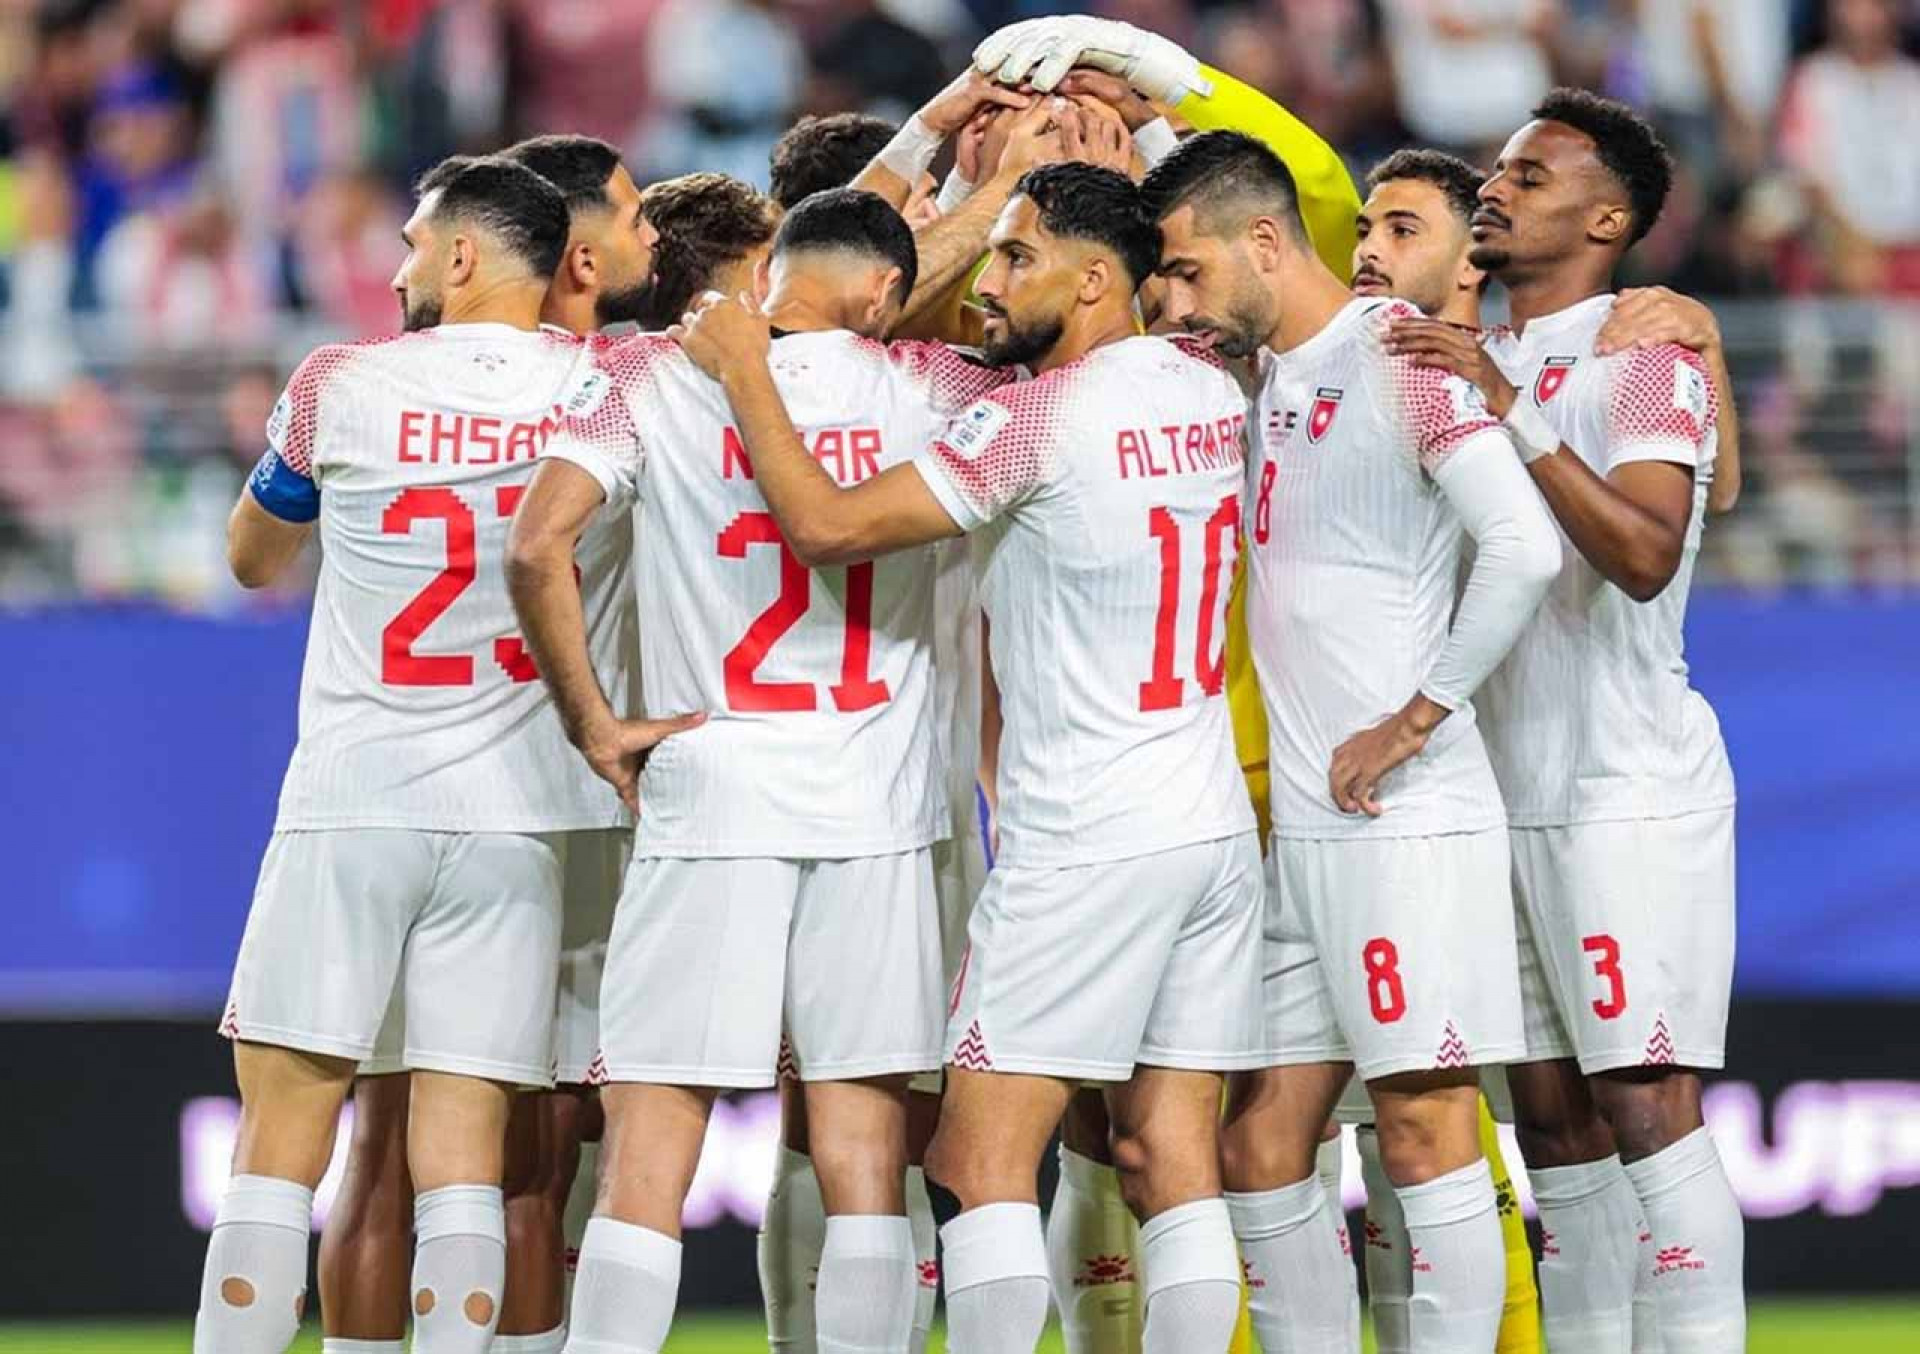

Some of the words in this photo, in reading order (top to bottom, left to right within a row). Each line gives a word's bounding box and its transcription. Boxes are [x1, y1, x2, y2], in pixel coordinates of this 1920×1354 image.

[722, 425, 883, 483] NAR
[1255, 460, 1278, 544] 8
[1139, 494, 1243, 712] 10
[1362, 937, 1407, 1025] 8
[1583, 934, 1627, 1020] 3
